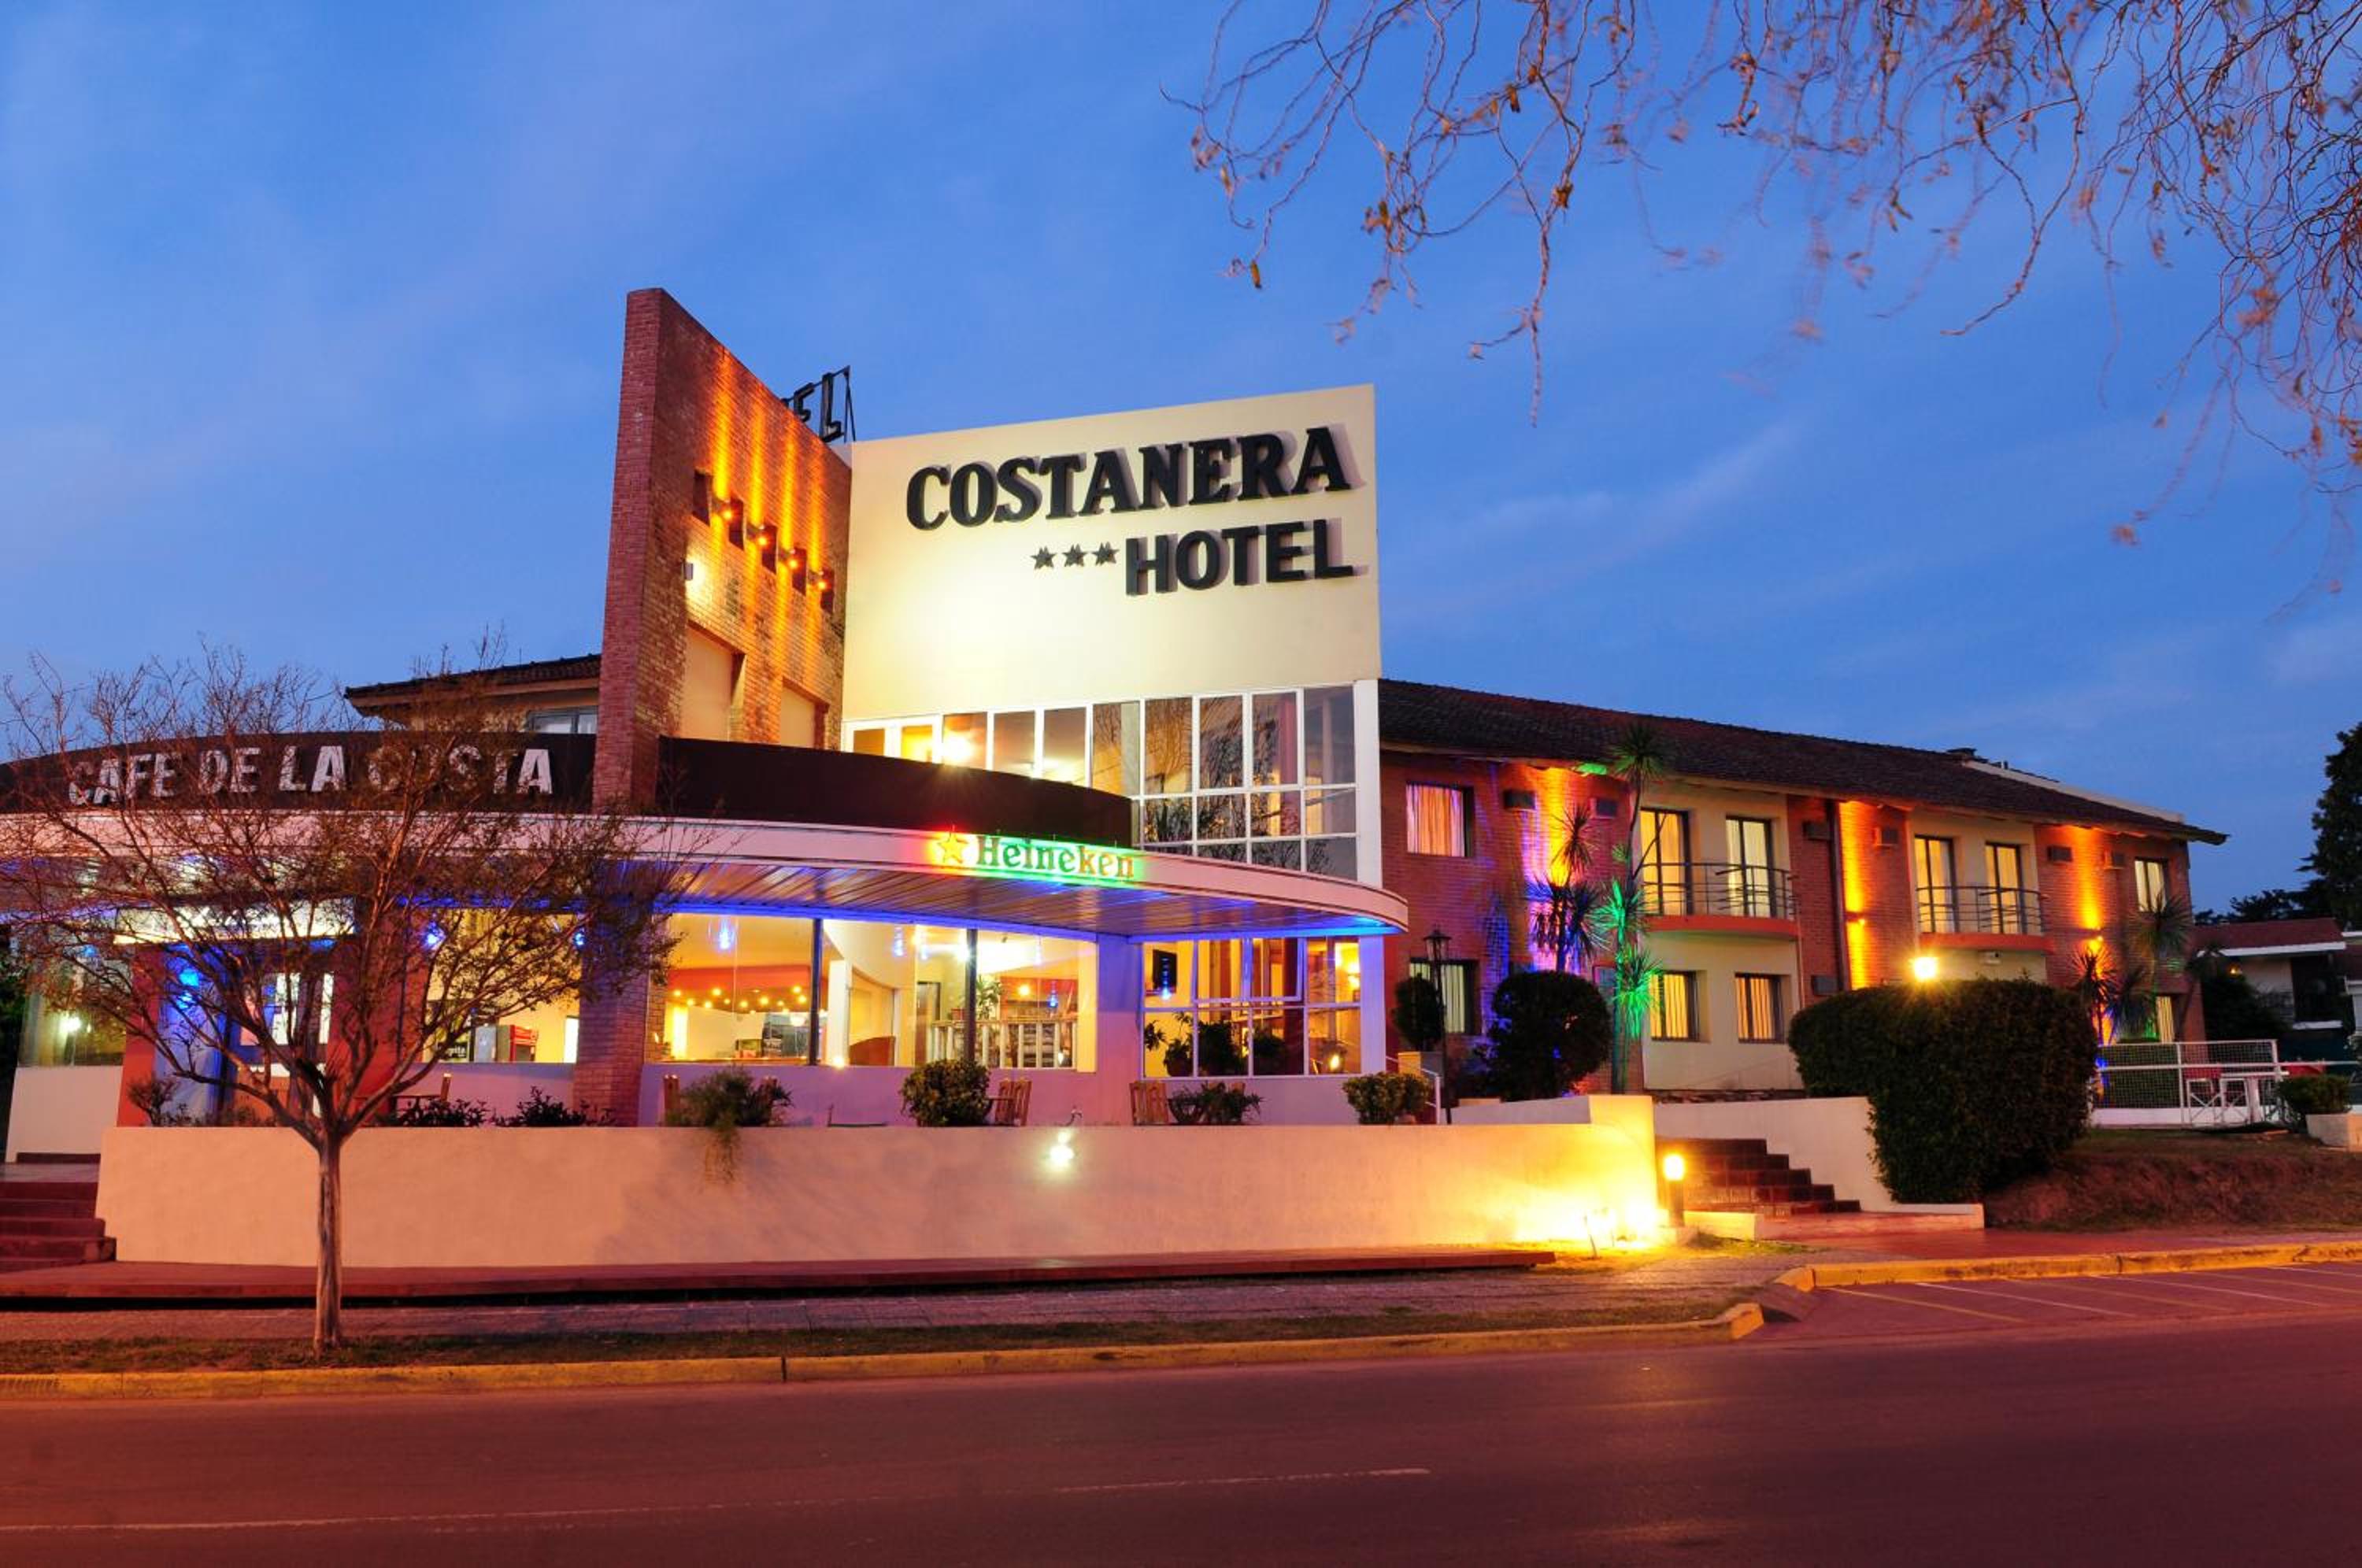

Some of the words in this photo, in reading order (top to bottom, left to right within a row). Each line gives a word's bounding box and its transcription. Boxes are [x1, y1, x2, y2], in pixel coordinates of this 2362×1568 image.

[907, 426, 1354, 531] COSTANERA
[1126, 518, 1356, 596] HOTEL
[68, 753, 183, 806] CAFE
[198, 746, 261, 794] DE
[278, 745, 347, 793] LA
[976, 834, 1135, 879] Heineken
